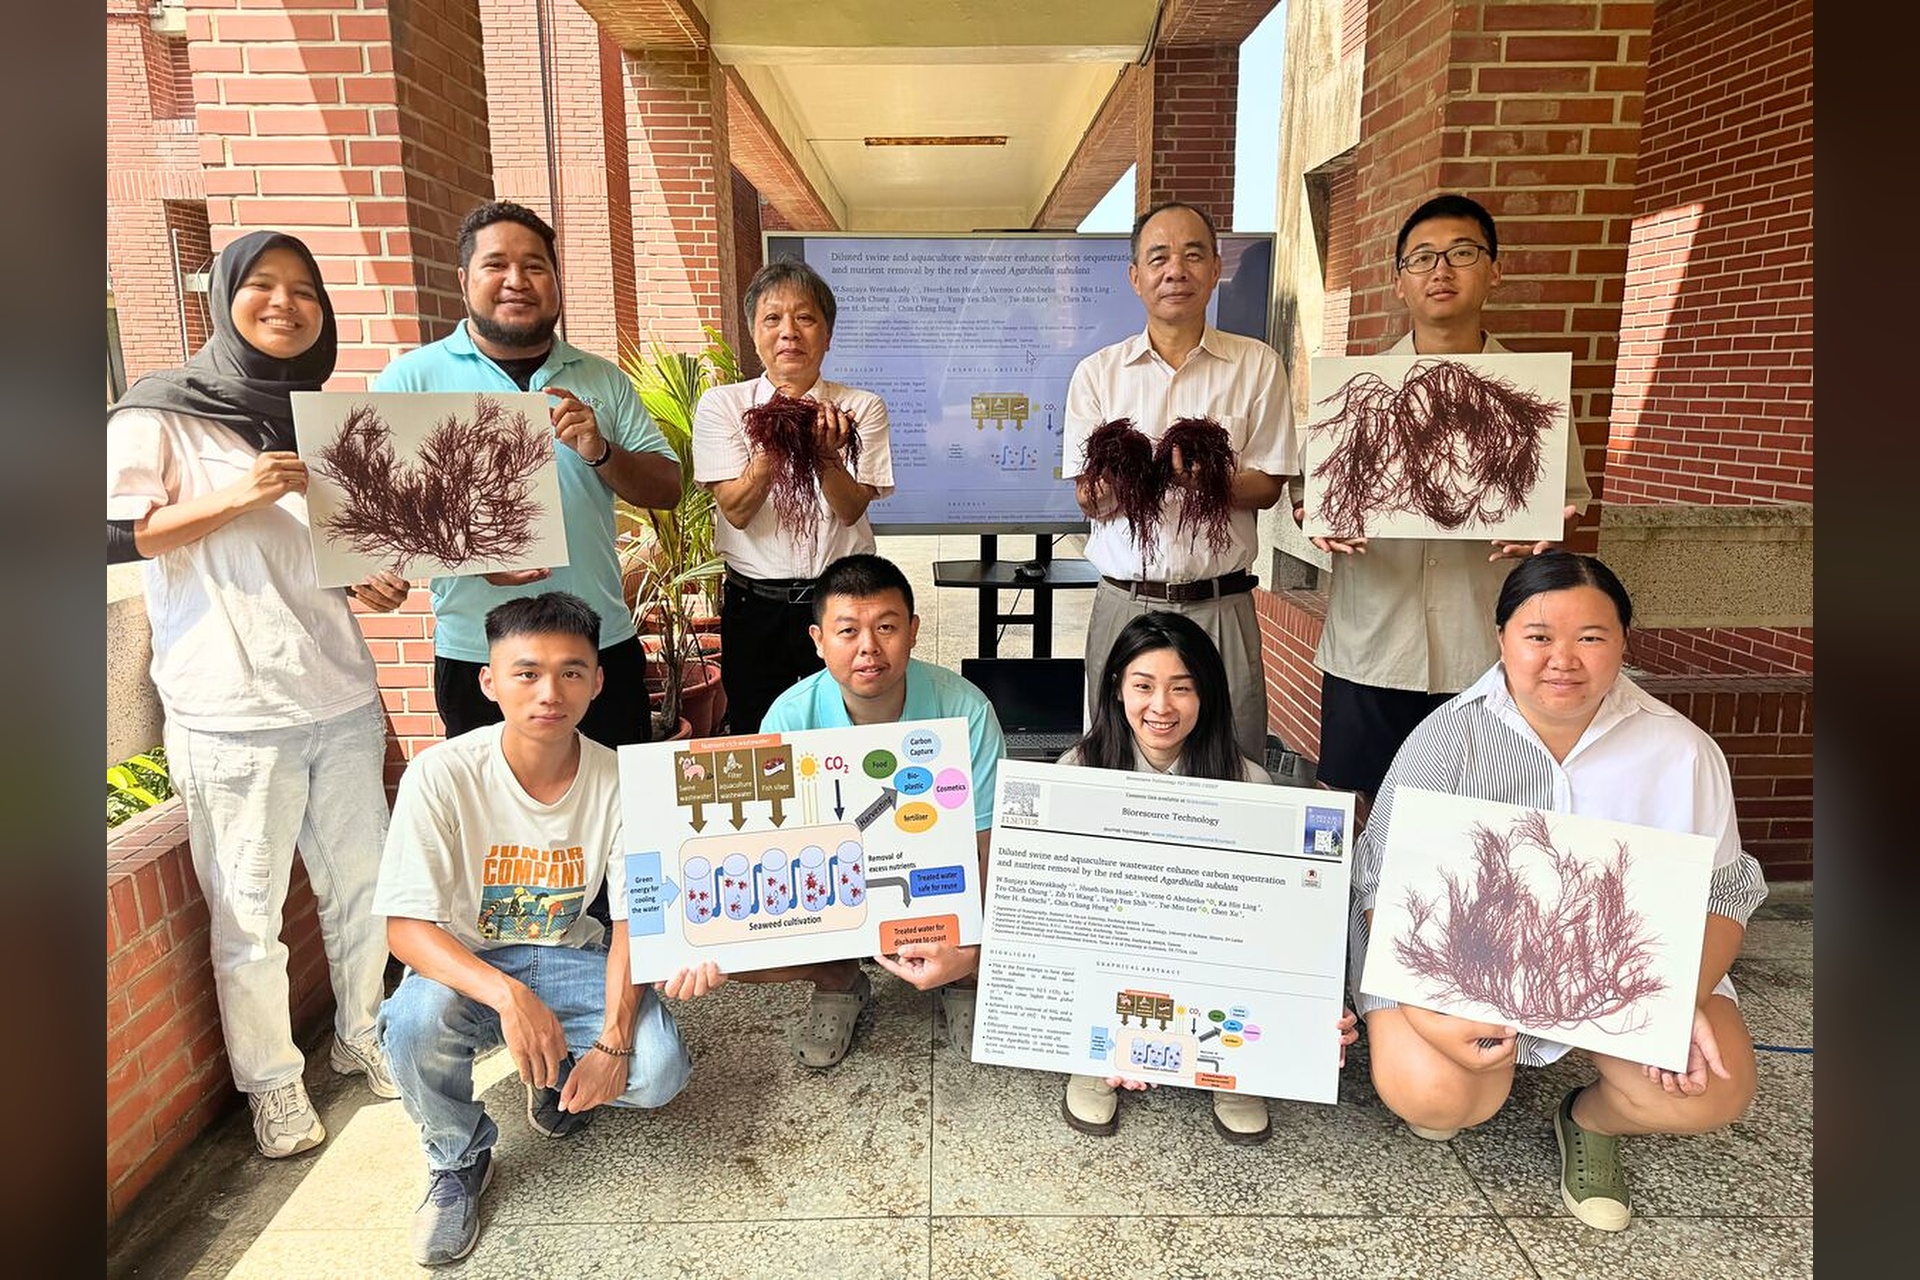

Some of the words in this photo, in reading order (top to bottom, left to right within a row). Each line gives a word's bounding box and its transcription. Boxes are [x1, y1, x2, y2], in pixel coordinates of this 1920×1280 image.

[831, 253, 862, 261] Diluted
[892, 253, 908, 261] and
[911, 253, 961, 264] aquaculture
[965, 254, 1011, 262] wastewater
[1014, 253, 1049, 262] enhance
[1052, 253, 1080, 262] carbon
[831, 266, 847, 274] and
[850, 266, 884, 274] nutrient
[888, 266, 921, 274] removal
[925, 266, 934, 276] by
[938, 266, 951, 274] the
[971, 267, 1006, 275] seaweed
[1009, 267, 1054, 276] Agardhiella
[1057, 267, 1090, 275] subulata
[910, 736, 931, 745] Carbon
[909, 746, 933, 756] Capture
[872, 760, 887, 768] Food
[904, 782, 924, 791] plastic
[936, 783, 965, 792] Cosmetics
[860, 796, 892, 827] Harvesting
[1122, 807, 1169, 820] Bioresource
[1171, 812, 1219, 827] Technology
[486, 845, 583, 862] JUNIOR
[868, 853, 893, 862] Removal
[888, 862, 916, 871] nutrients
[998, 847, 1026, 857] Diluted
[1029, 851, 1051, 860] swine
[1053, 853, 1068, 861] and
[1070, 854, 1116, 868] aquaculture
[1118, 860, 1163, 872] wastewater
[1166, 865, 1199, 875] enhance
[1201, 869, 1229, 879] carbon
[1231, 872, 1285, 886] sequestration
[483, 859, 584, 888] COMPANY
[917, 872, 939, 881] Treated
[996, 858, 1011, 866] and
[1014, 860, 1045, 870] nutrient
[1047, 863, 1079, 874] removal
[1081, 867, 1091, 876] by
[1094, 868, 1107, 876] the
[1109, 870, 1122, 878] red
[1124, 872, 1157, 882] seaweed
[1159, 876, 1203, 889] Agardhiella
[1205, 881, 1238, 891] subulata
[635, 875, 653, 883] Green
[629, 886, 650, 894] energy
[634, 895, 656, 904] cooling
[749, 919, 782, 930] Seaweed
[783, 915, 821, 926] cultivation
[894, 926, 917, 935] Treated
